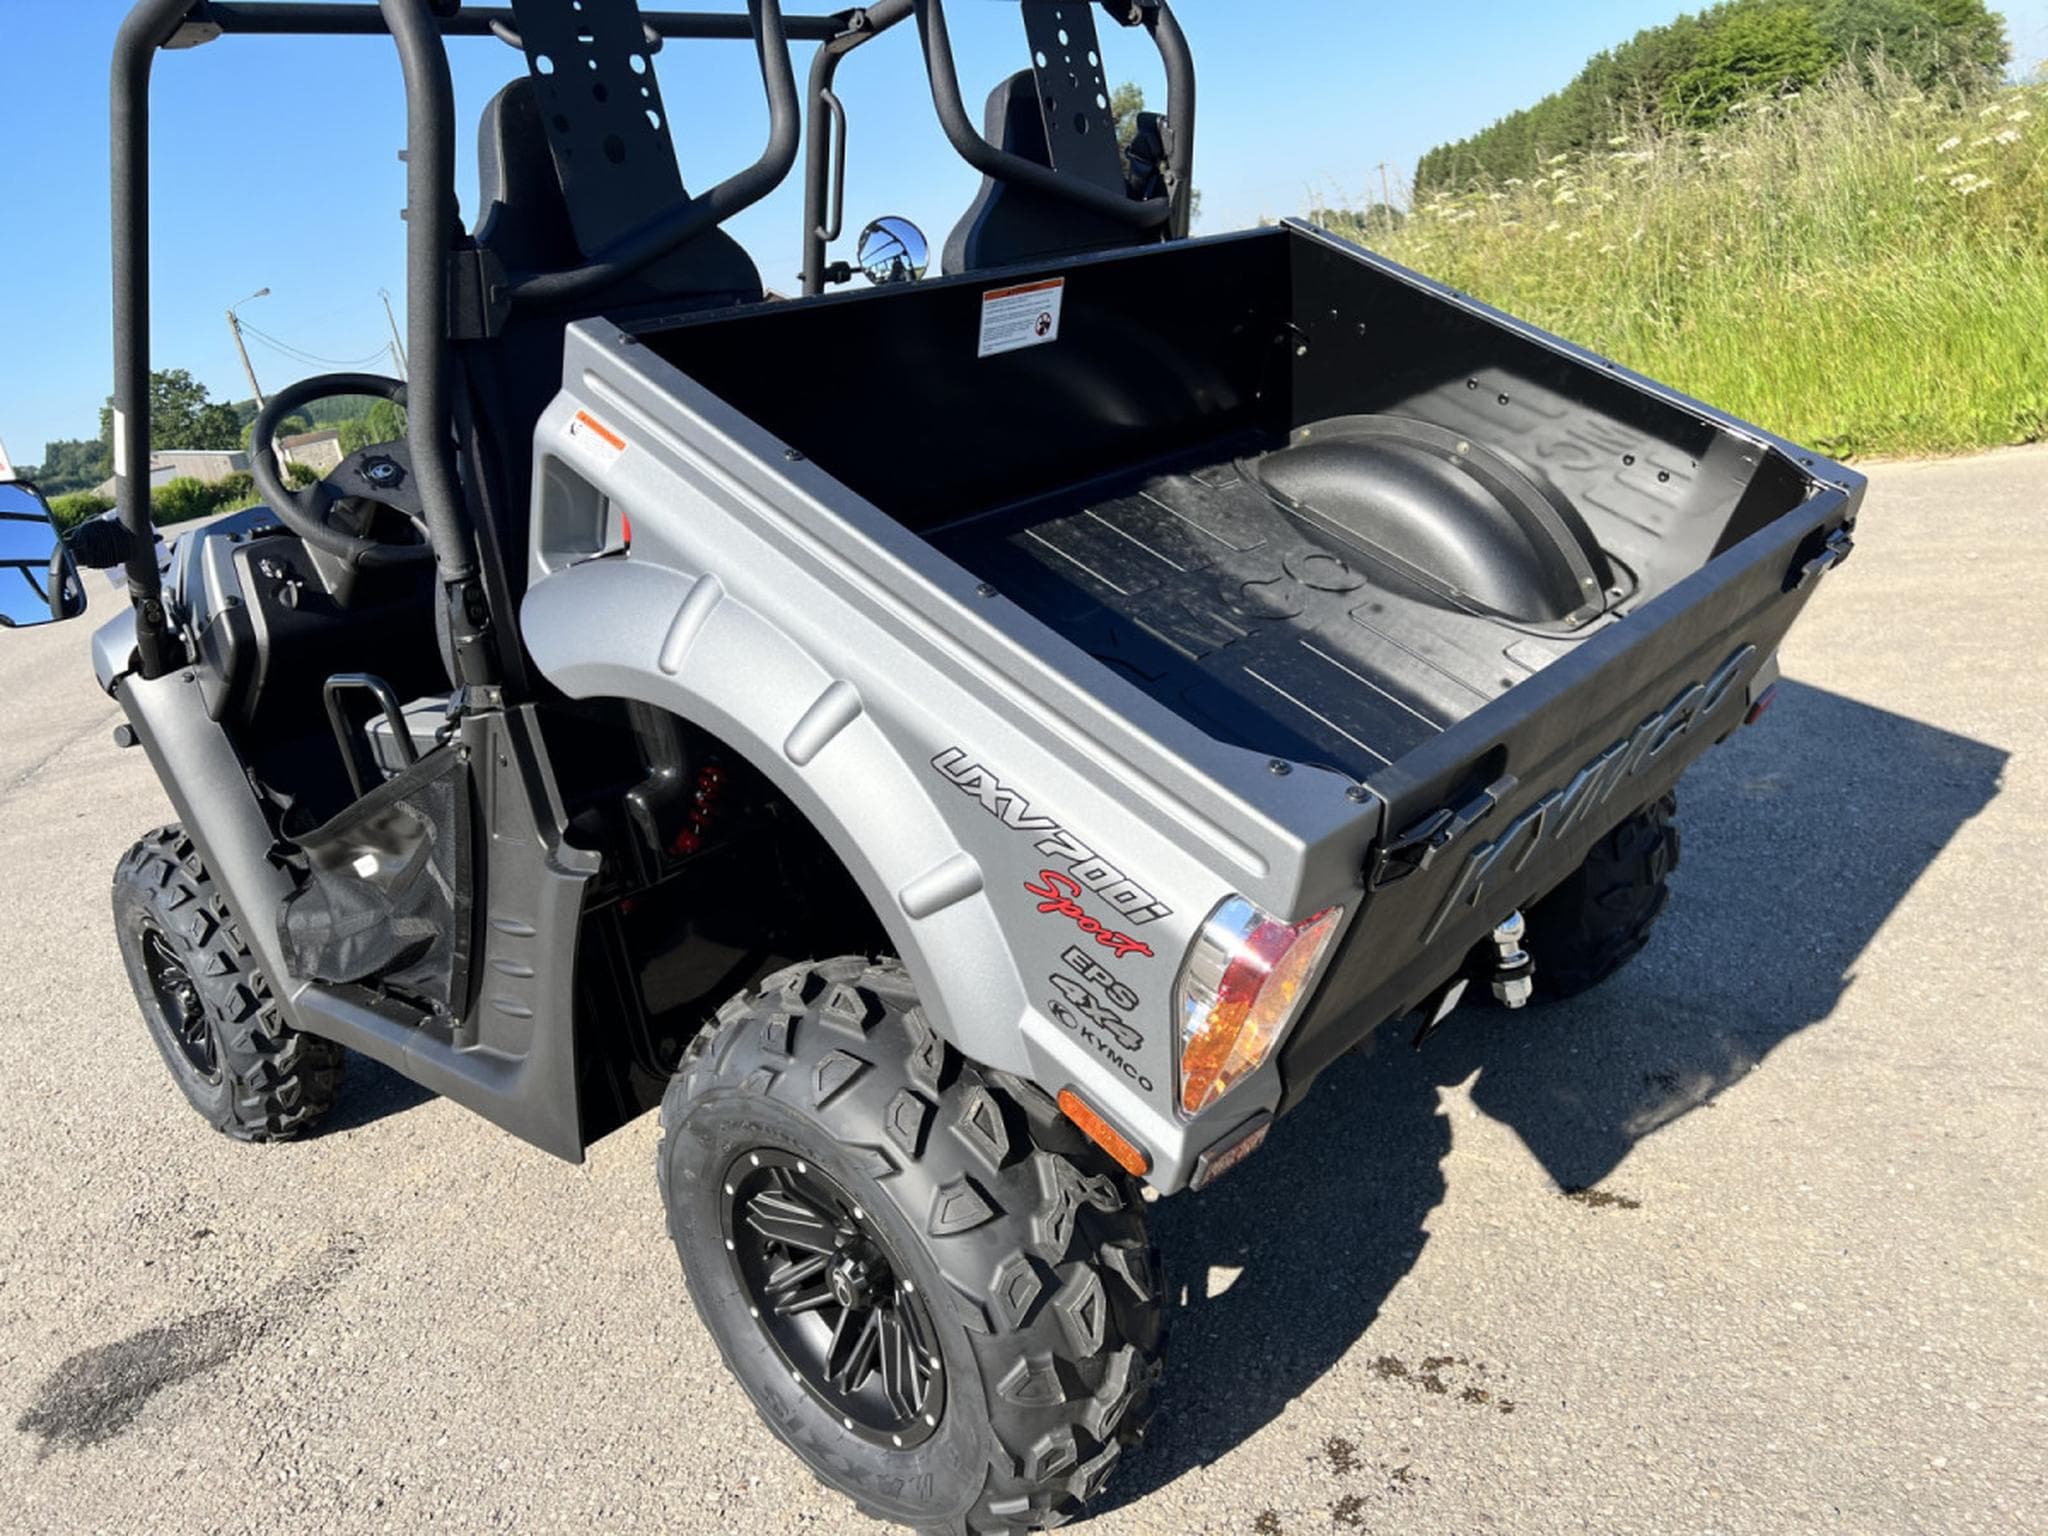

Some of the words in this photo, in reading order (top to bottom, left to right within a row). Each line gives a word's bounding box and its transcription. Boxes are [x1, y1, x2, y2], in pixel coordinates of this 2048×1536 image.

[1023, 869, 1155, 958] Sport
[1061, 945, 1139, 1011] EPS
[1080, 1027, 1153, 1091] KYMCO
